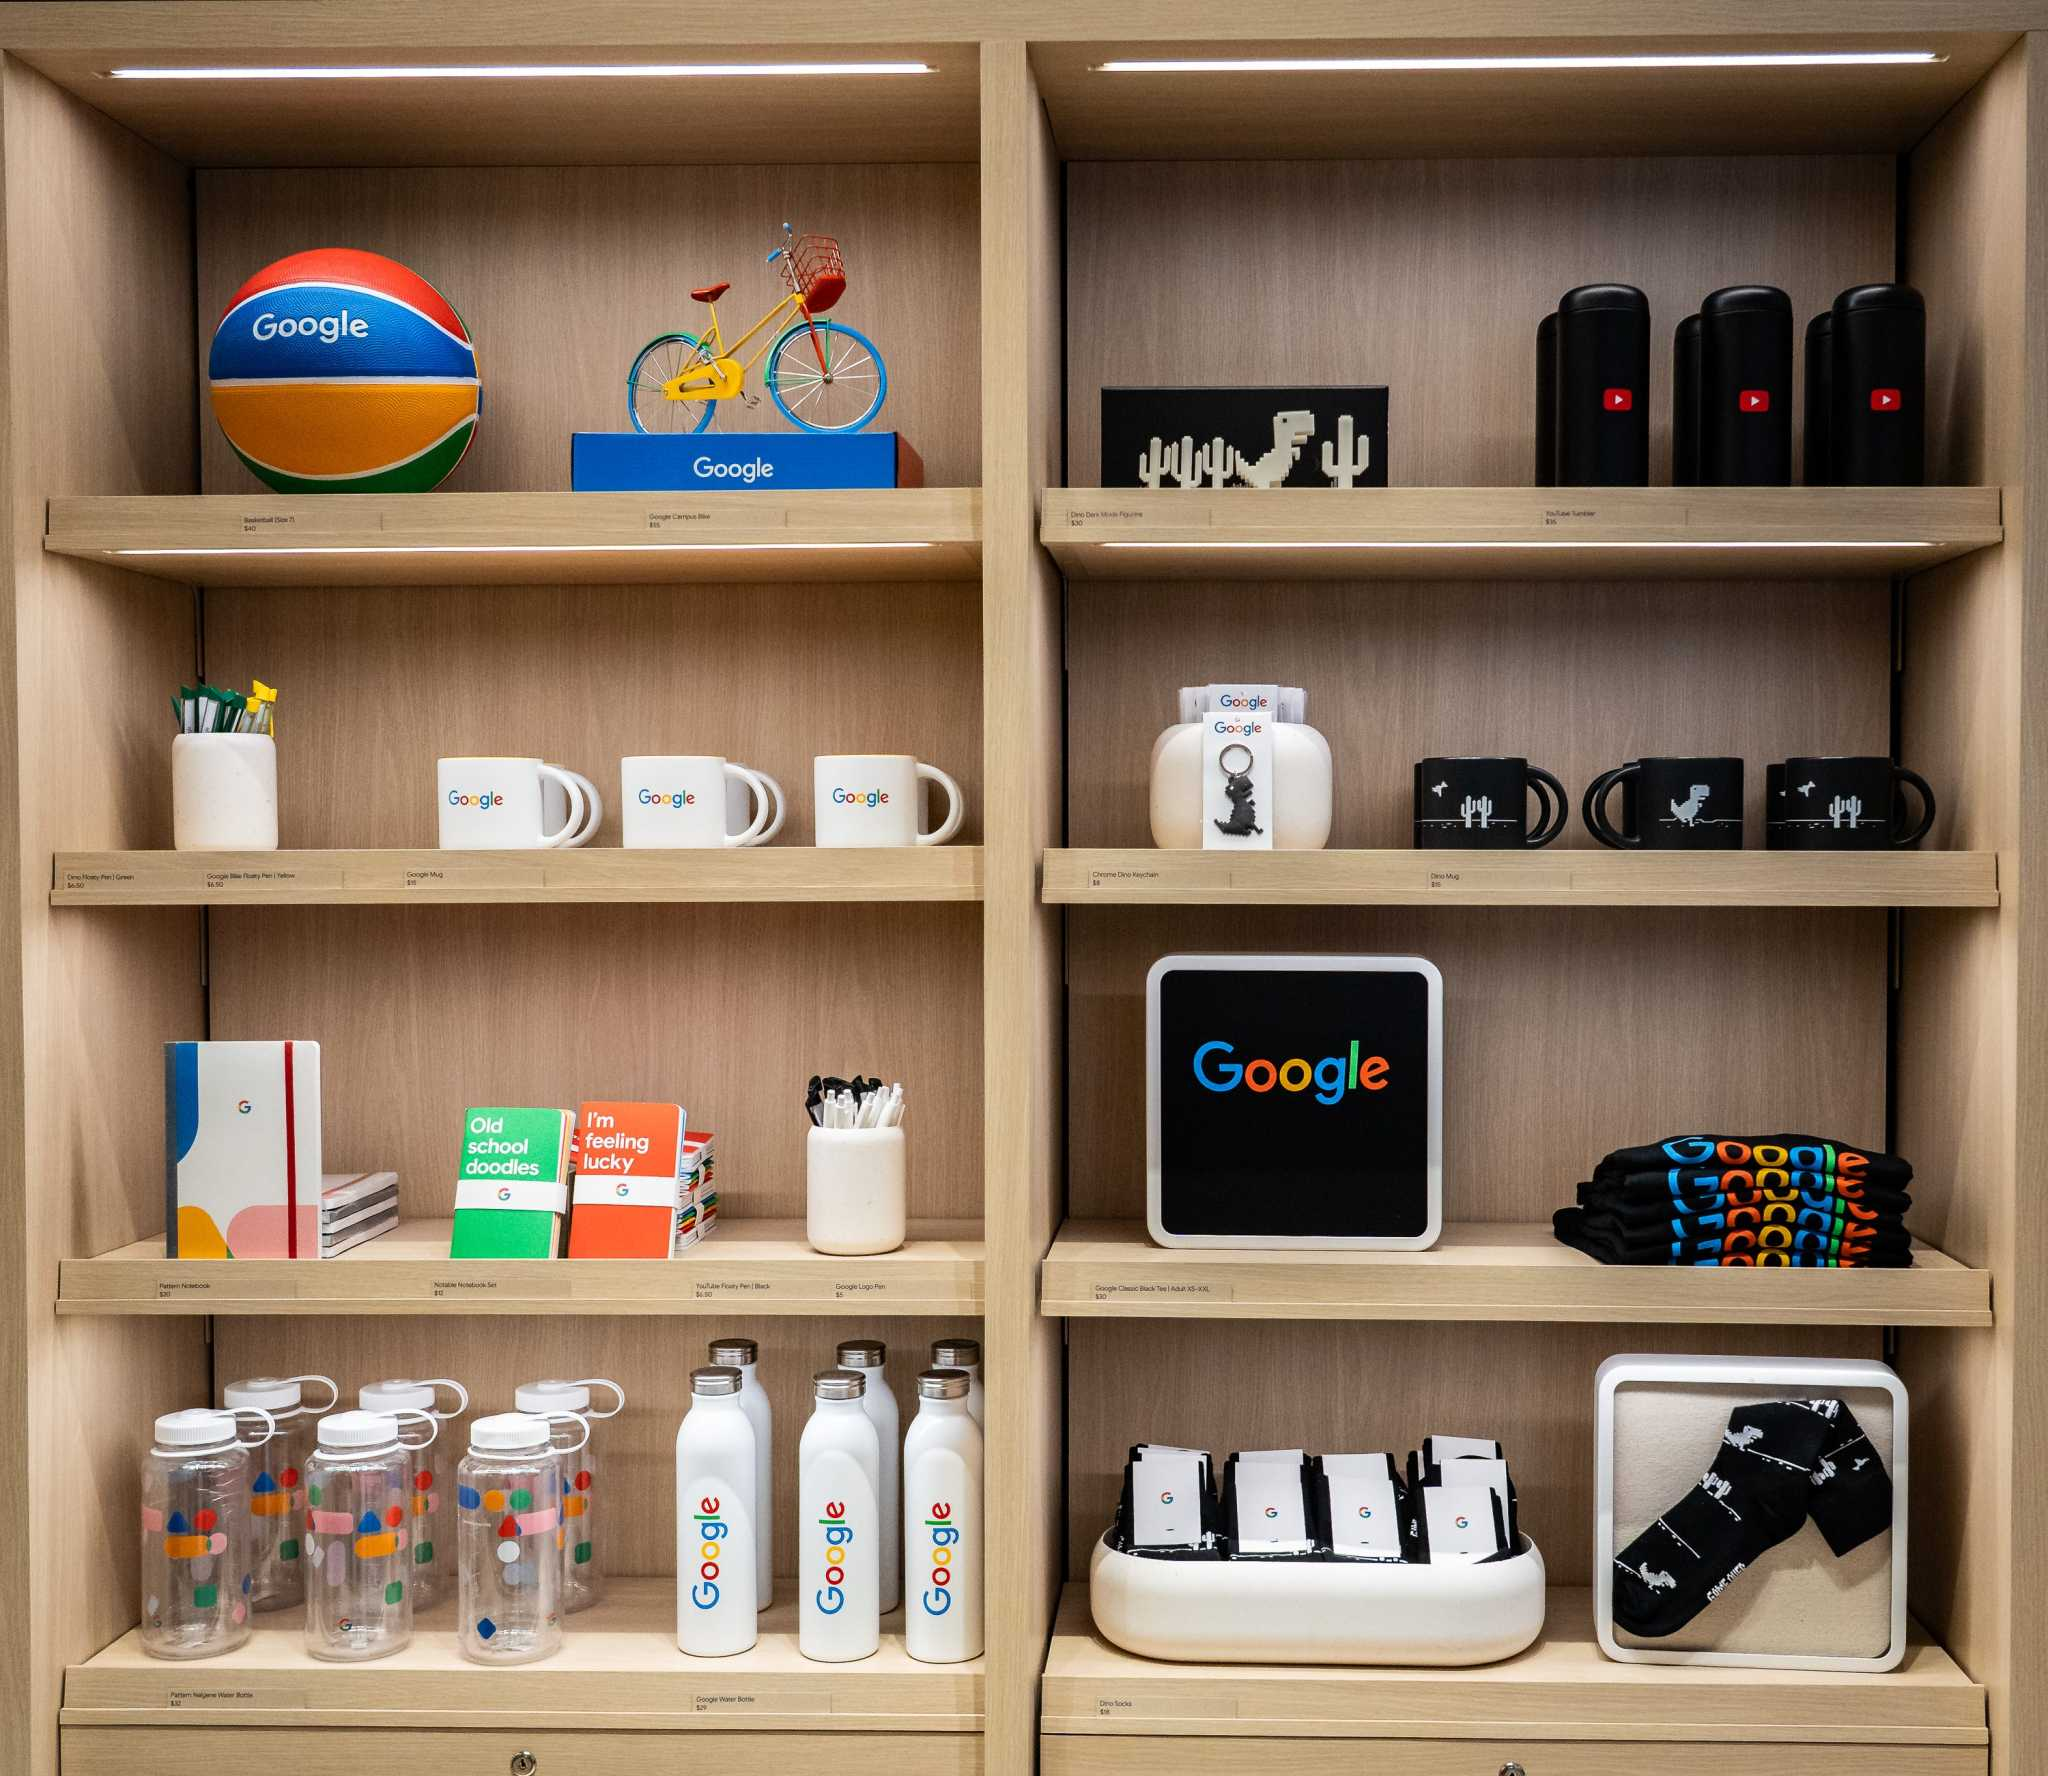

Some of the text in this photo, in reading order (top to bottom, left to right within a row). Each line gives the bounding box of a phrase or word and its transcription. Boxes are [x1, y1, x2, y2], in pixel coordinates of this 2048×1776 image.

[252, 309, 370, 344] Google
[693, 456, 774, 484] Google
[649, 513, 671, 521] Google
[672, 513, 697, 521] Campus
[1220, 694, 1267, 710] Google
[1214, 721, 1262, 736] Google
[448, 789, 503, 809] Google
[638, 788, 695, 808] Google
[832, 787, 889, 807] Google
[206, 873, 228, 881] Google
[407, 871, 443, 879] Google Mug
[1132, 871, 1159, 879] Keychain
[1193, 1040, 1390, 1105] Google
[238, 1100, 251, 1114] G
[470, 1116, 504, 1134] Old
[587, 1111, 614, 1129] I'm
[467, 1138, 528, 1155] school
[584, 1132, 649, 1154] feeling
[465, 1159, 540, 1176] doodles
[583, 1153, 635, 1175] lucky
[498, 1187, 511, 1201] G
[616, 1183, 629, 1197] G
[835, 1283, 858, 1291] Google
[859, 1283, 874, 1291] Logo
[1095, 1285, 1117, 1293] Google
[1160, 1491, 1174, 1505] G
[1265, 1506, 1278, 1519] G
[1358, 1506, 1372, 1519] G
[1455, 1515, 1468, 1529] G
[691, 1497, 728, 1610] Google
[816, 1501, 853, 1615] Google
[923, 1502, 959, 1616] Google
[337, 1617, 353, 1631] G
[696, 1696, 718, 1704] Google
